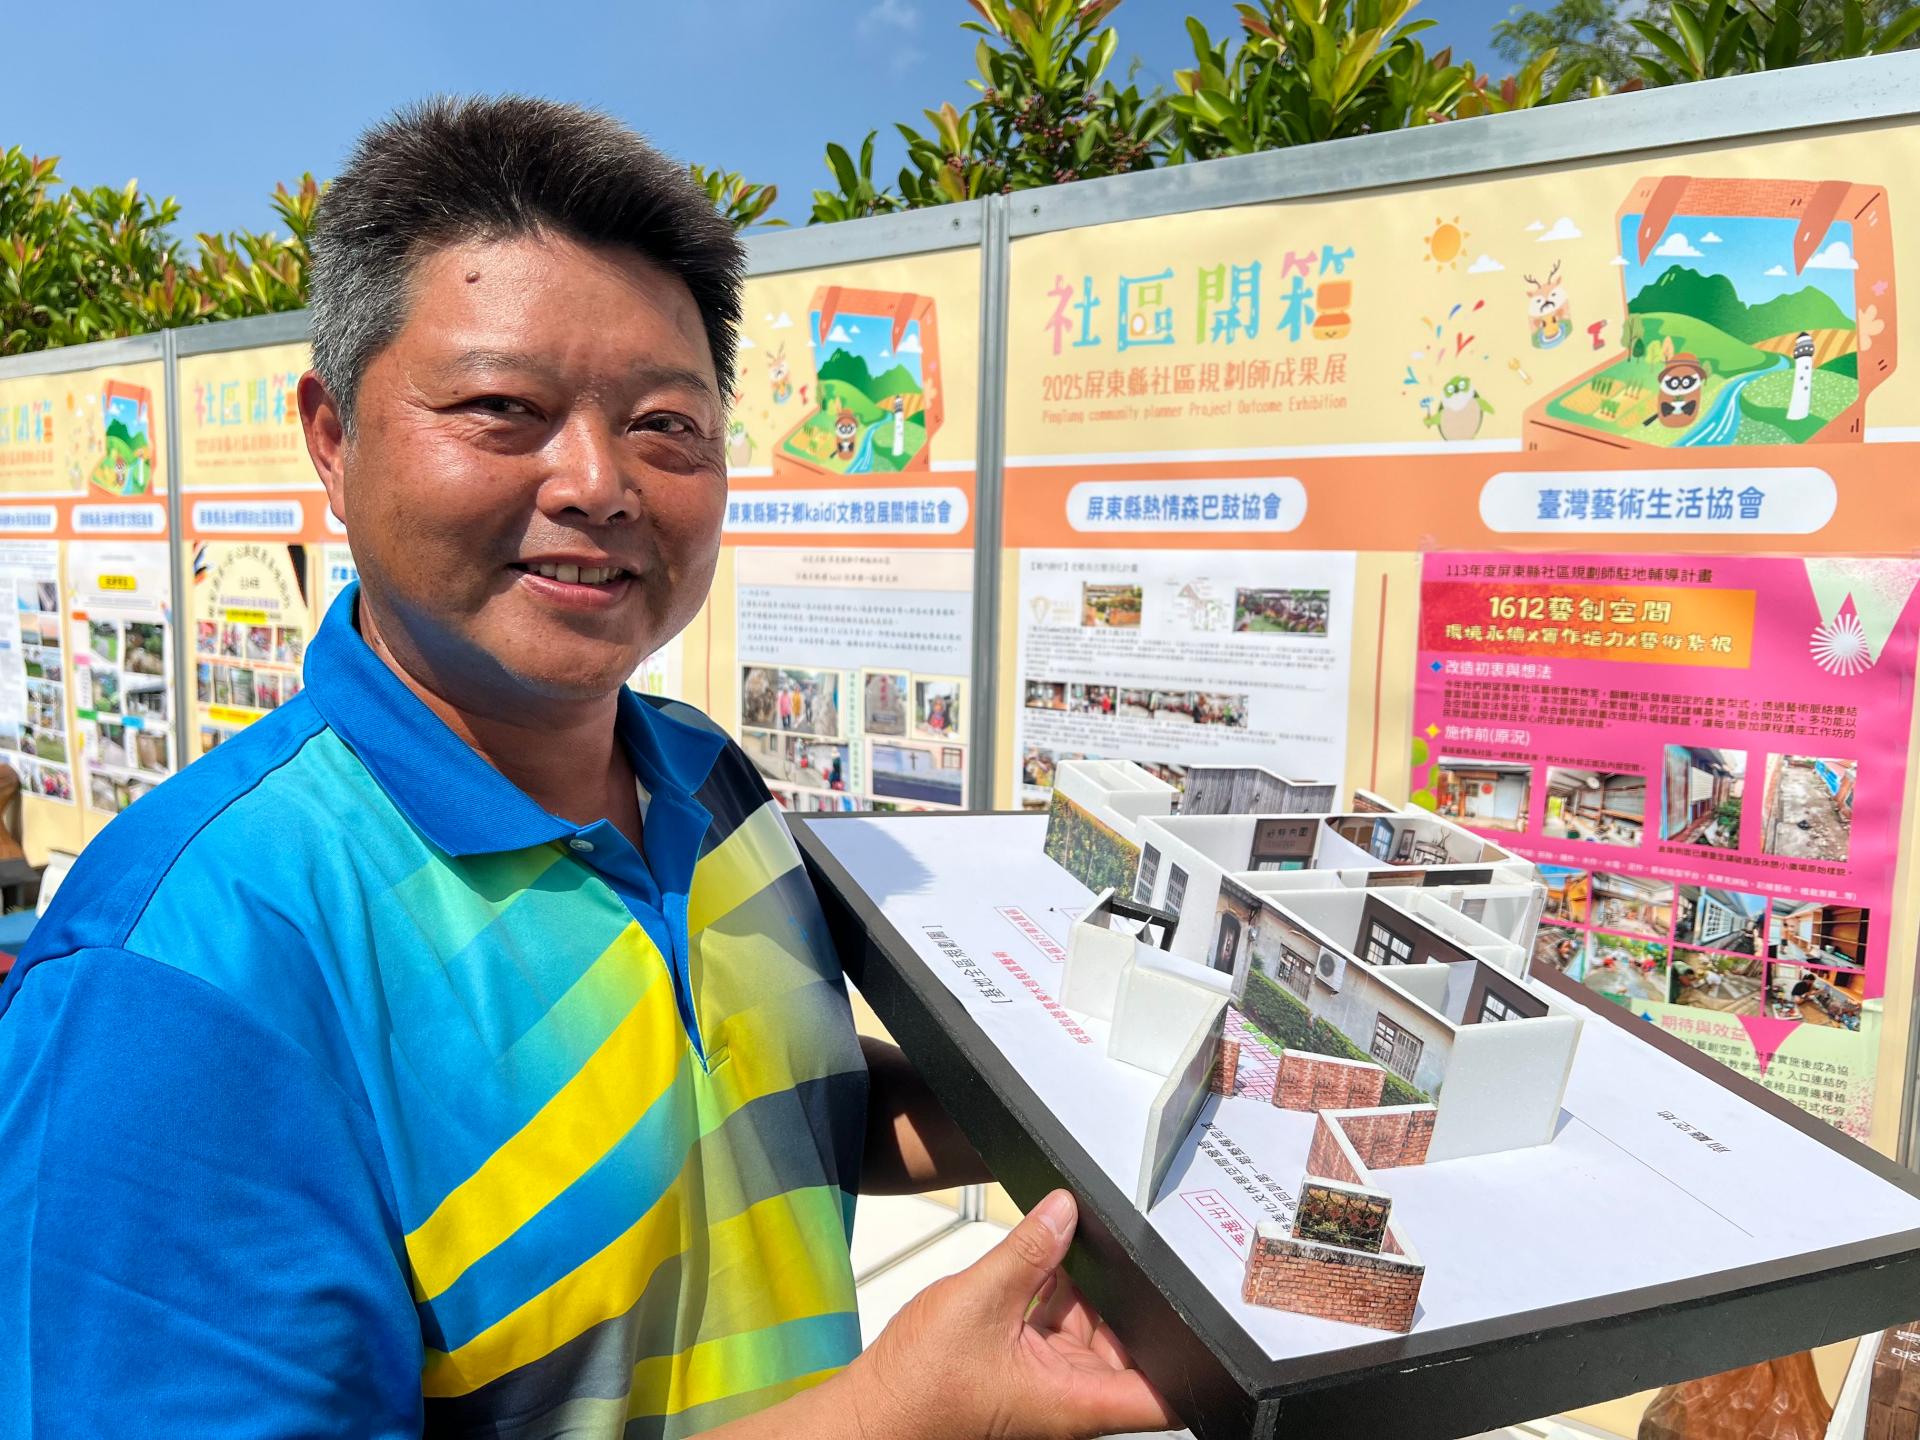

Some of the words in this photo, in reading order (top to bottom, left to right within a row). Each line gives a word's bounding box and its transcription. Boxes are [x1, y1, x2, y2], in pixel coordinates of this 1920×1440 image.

[1045, 245, 1355, 356] 社區開箱
[1042, 354, 1347, 402] 2025屏東縣社區規劃師成果展
[1189, 400, 1232, 418] Project
[1237, 399, 1283, 415] Outcome
[1288, 394, 1348, 412] Exhibition
[728, 500, 952, 525] 屏東縣獅子鄉kaidi文教發展關懷協會
[1086, 492, 1282, 522] 屏東縣熱情森巴鼓協會
[1536, 486, 1766, 521] 臺灣藝術生活協會
[1445, 563, 1713, 584] 113年度屏東縣社區規劃師駐地輔導計畫
[1488, 596, 1673, 624] 1612藝創空間
[1445, 659, 1552, 680] 改造初衷與想法
[1444, 725, 1531, 747] 施作前(原況)
[1662, 1015, 1747, 1042] 期待與效益
